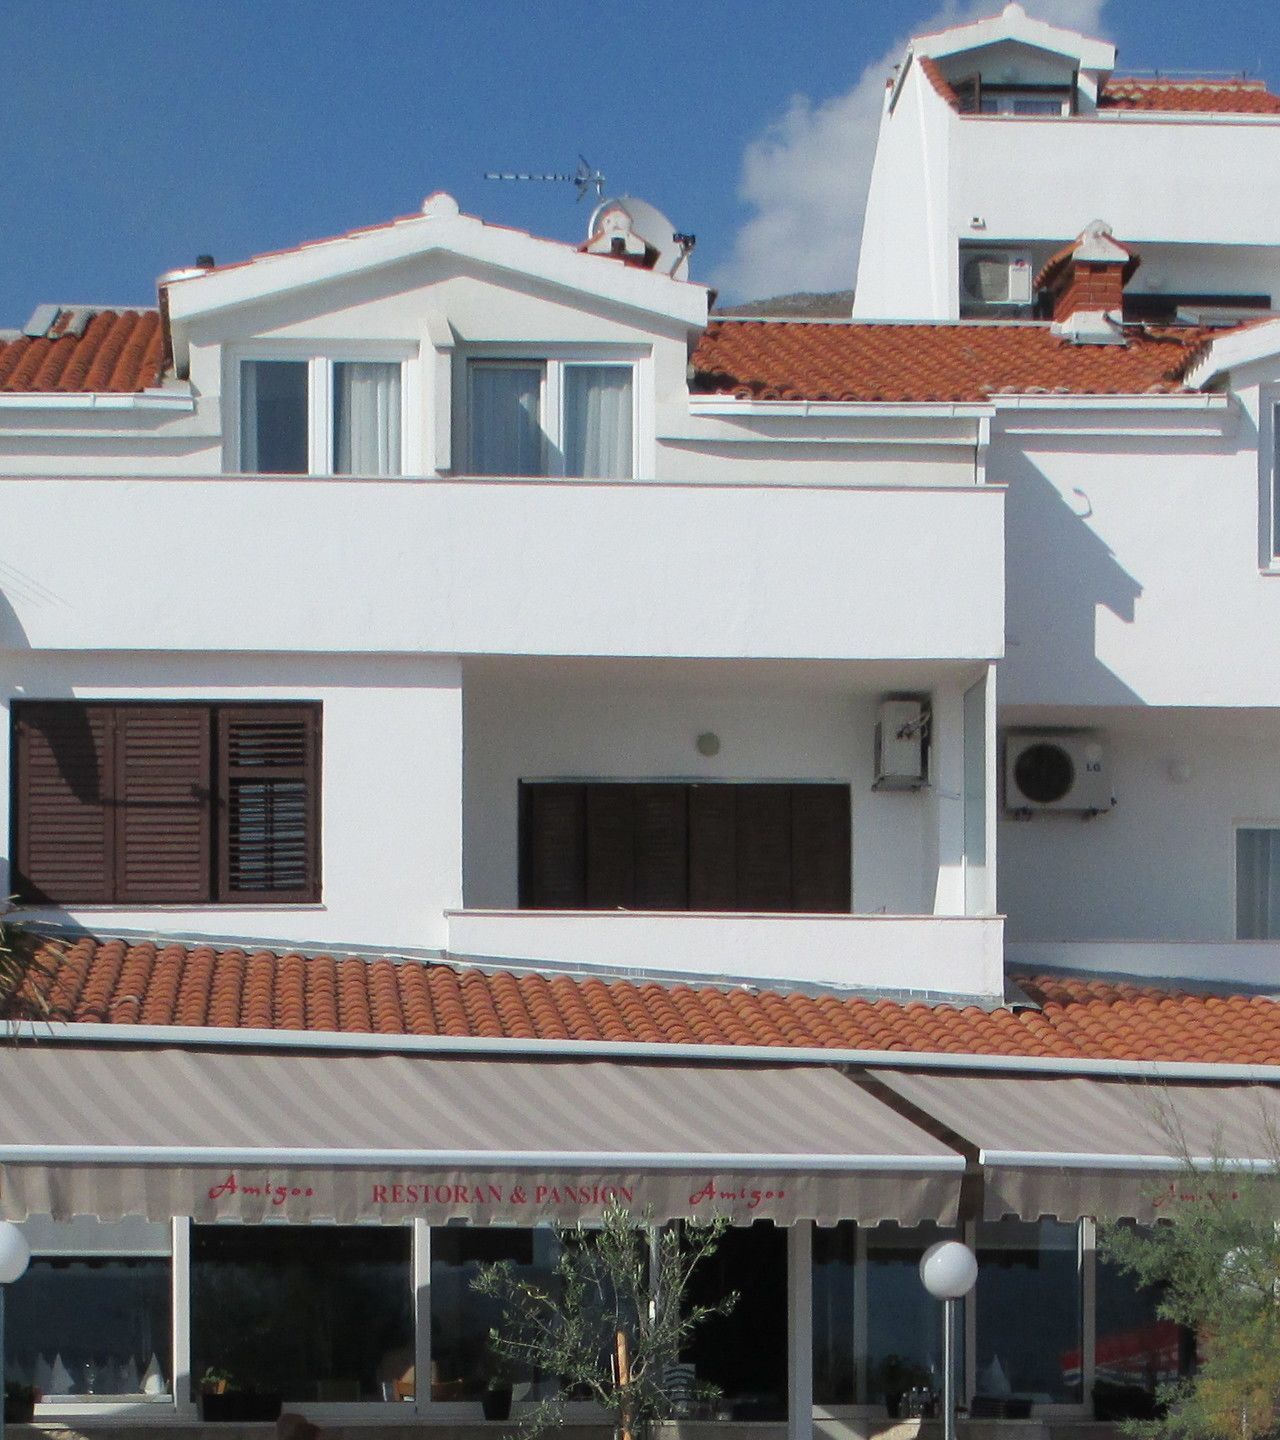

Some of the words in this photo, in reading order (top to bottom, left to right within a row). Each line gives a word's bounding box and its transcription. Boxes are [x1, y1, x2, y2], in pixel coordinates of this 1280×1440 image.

[208, 1173, 314, 1206] Amigos
[373, 1184, 503, 1204] RESTORAN
[509, 1185, 527, 1204] &
[535, 1184, 634, 1204] PANSION
[689, 1178, 786, 1208] Amigos
